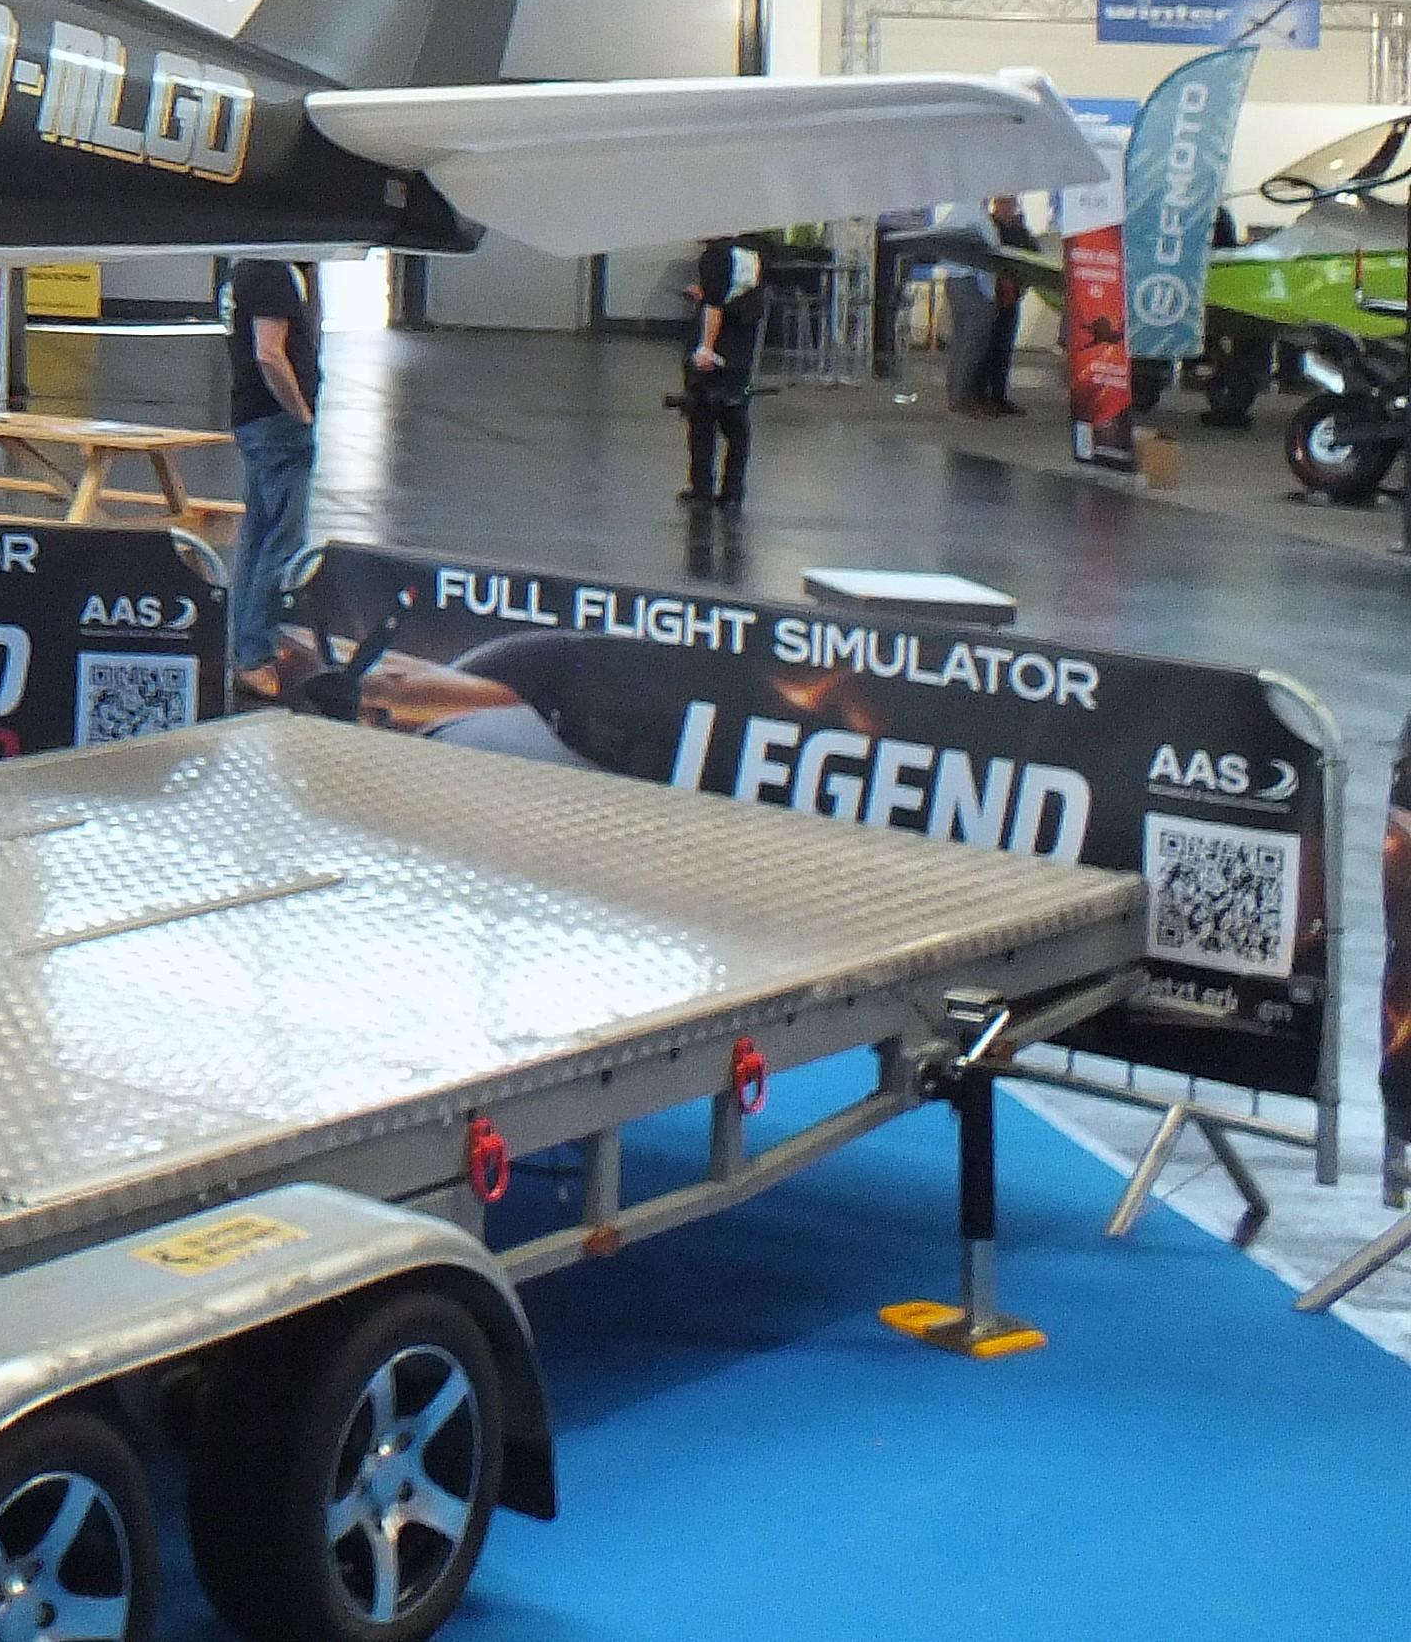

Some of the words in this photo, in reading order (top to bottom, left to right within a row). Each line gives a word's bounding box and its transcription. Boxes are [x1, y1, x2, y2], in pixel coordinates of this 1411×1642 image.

[1156, 82, 1210, 267] CFMOTO
[80, 594, 164, 629] AAS
[435, 567, 558, 626] FULL
[573, 585, 757, 655] FLIGHT
[773, 616, 1100, 711] SIMULATOR
[1147, 742, 1251, 795] AAS
